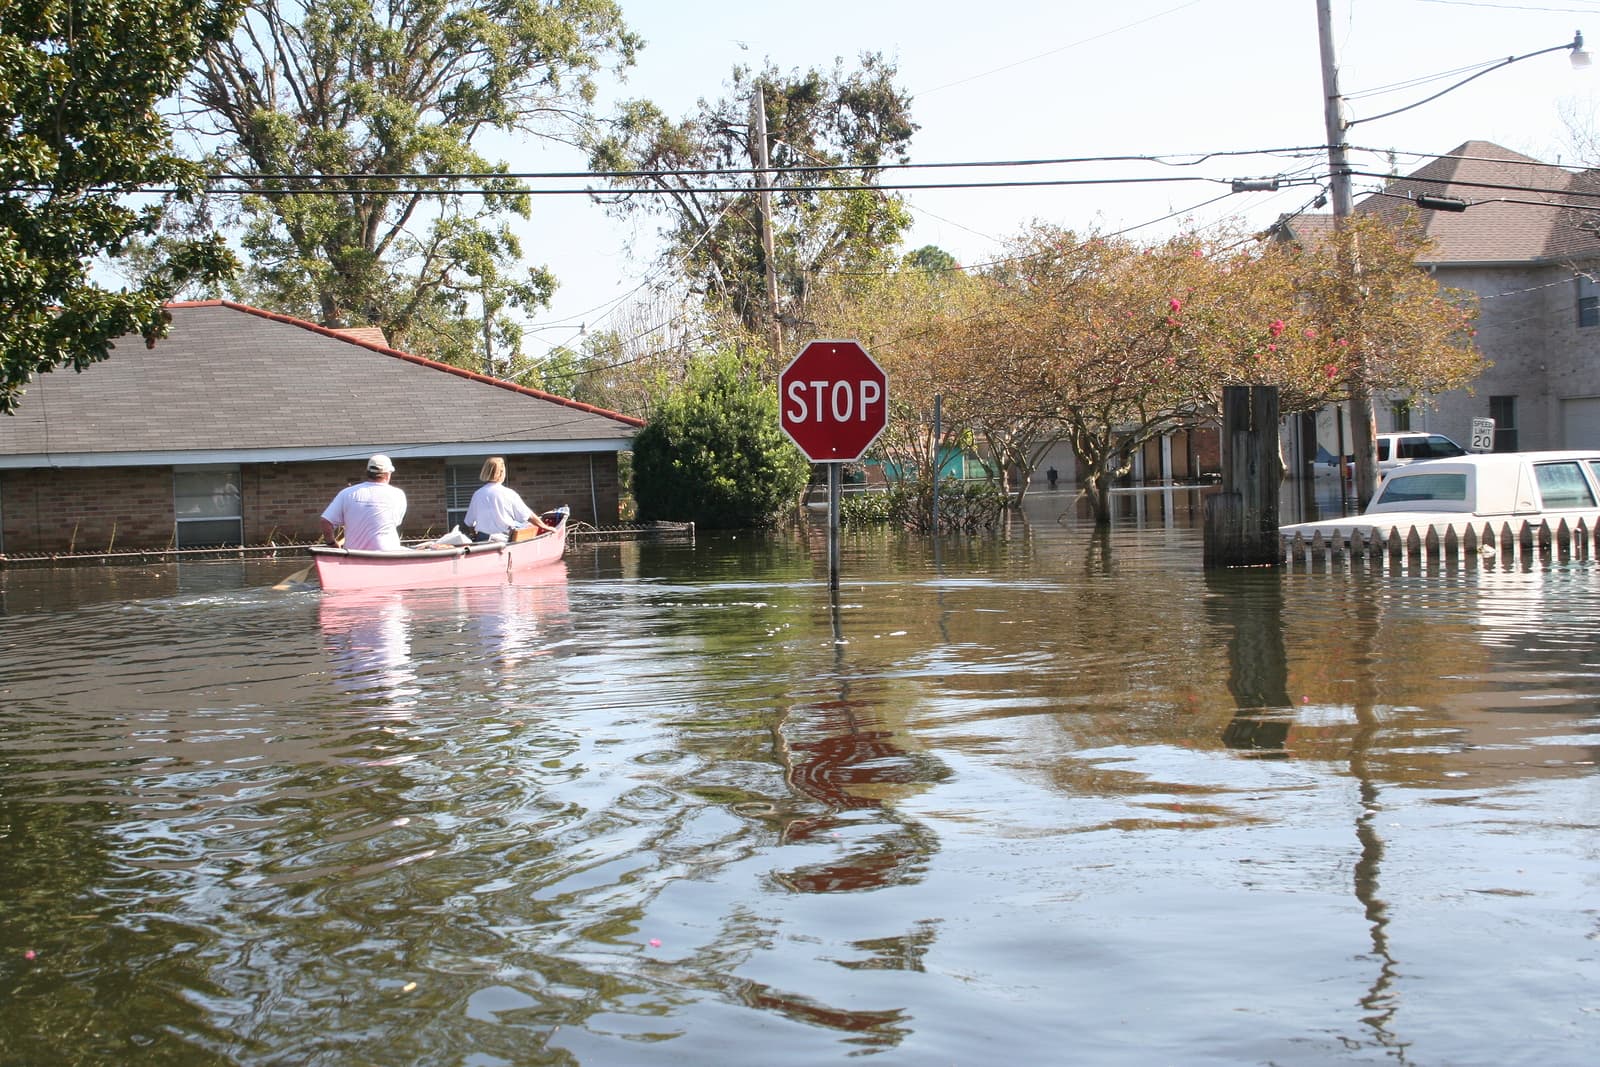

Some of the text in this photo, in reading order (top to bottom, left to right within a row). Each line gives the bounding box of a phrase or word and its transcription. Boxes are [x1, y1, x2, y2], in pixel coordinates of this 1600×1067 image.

[787, 380, 881, 423] STOP
[1473, 420, 1492, 428] SPEED
[1473, 435, 1491, 448] 20
